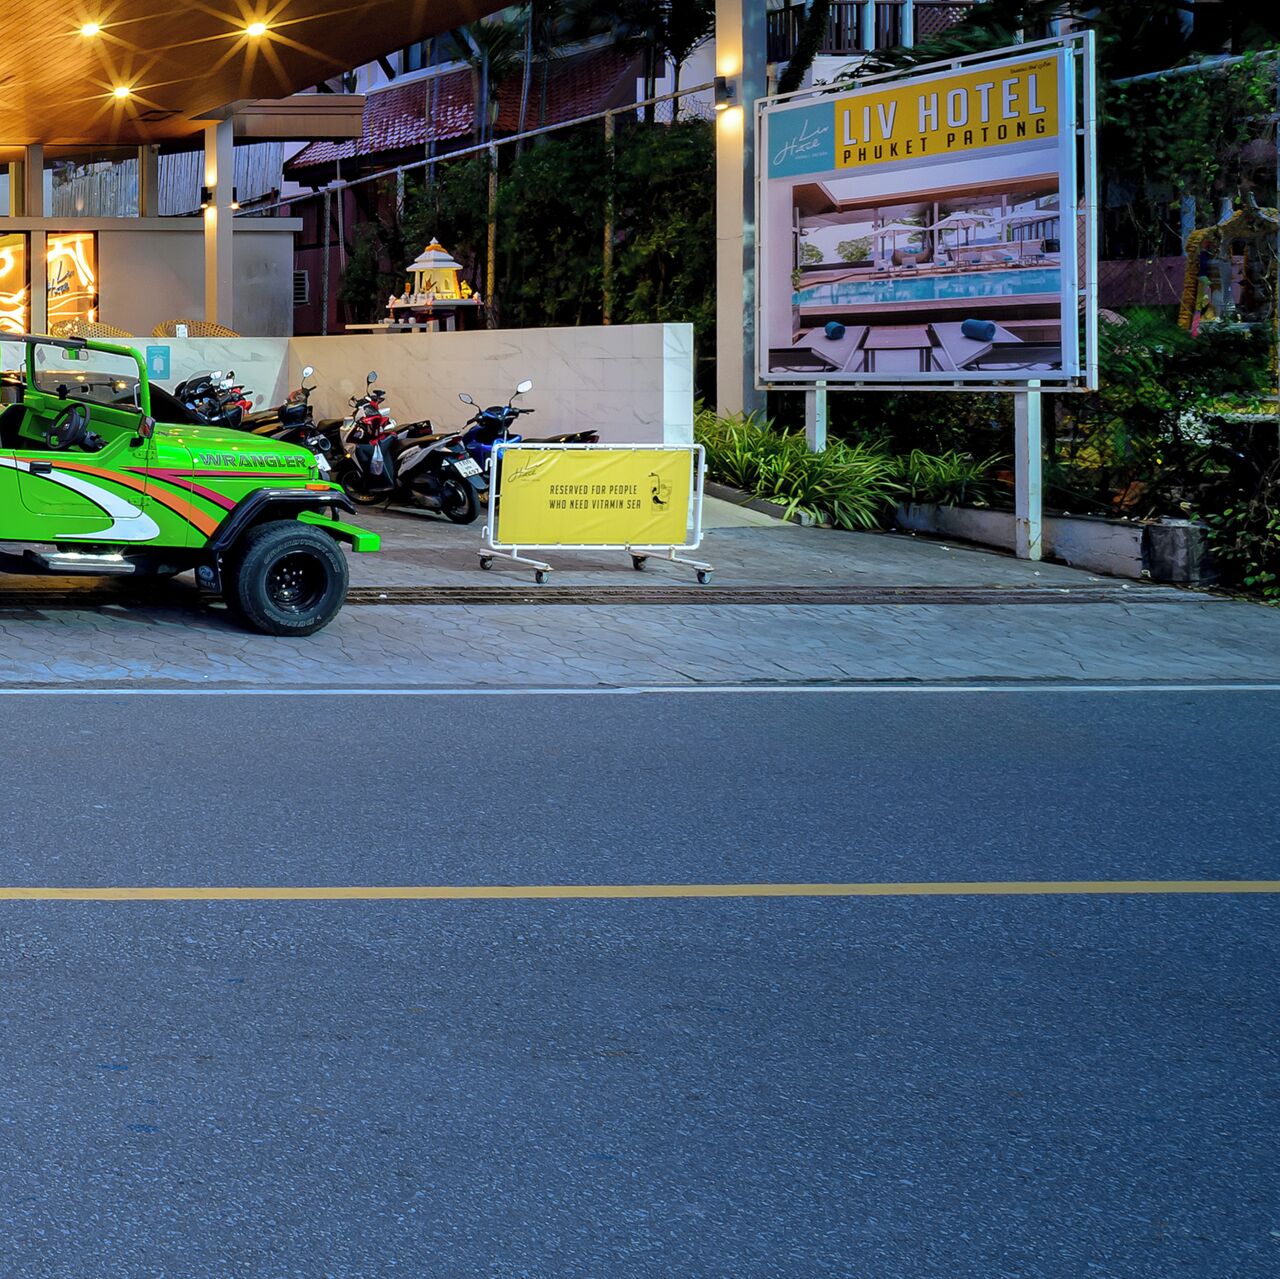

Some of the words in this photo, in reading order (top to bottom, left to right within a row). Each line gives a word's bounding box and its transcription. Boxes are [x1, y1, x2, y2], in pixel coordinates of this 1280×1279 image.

[843, 101, 897, 146] LIV
[918, 74, 1046, 133] HOTEL
[844, 137, 928, 163] PHUKET
[947, 118, 1046, 148] PATONG
[200, 453, 307, 468] WRANGLER
[549, 484, 589, 495] RESERVED
[591, 484, 606, 495] FOR
[609, 484, 638, 495] PEOPLE
[549, 499, 567, 510] WHO
[569, 499, 589, 510] NEED
[591, 499, 624, 510] VITAMIN
[626, 499, 641, 510] SEA
